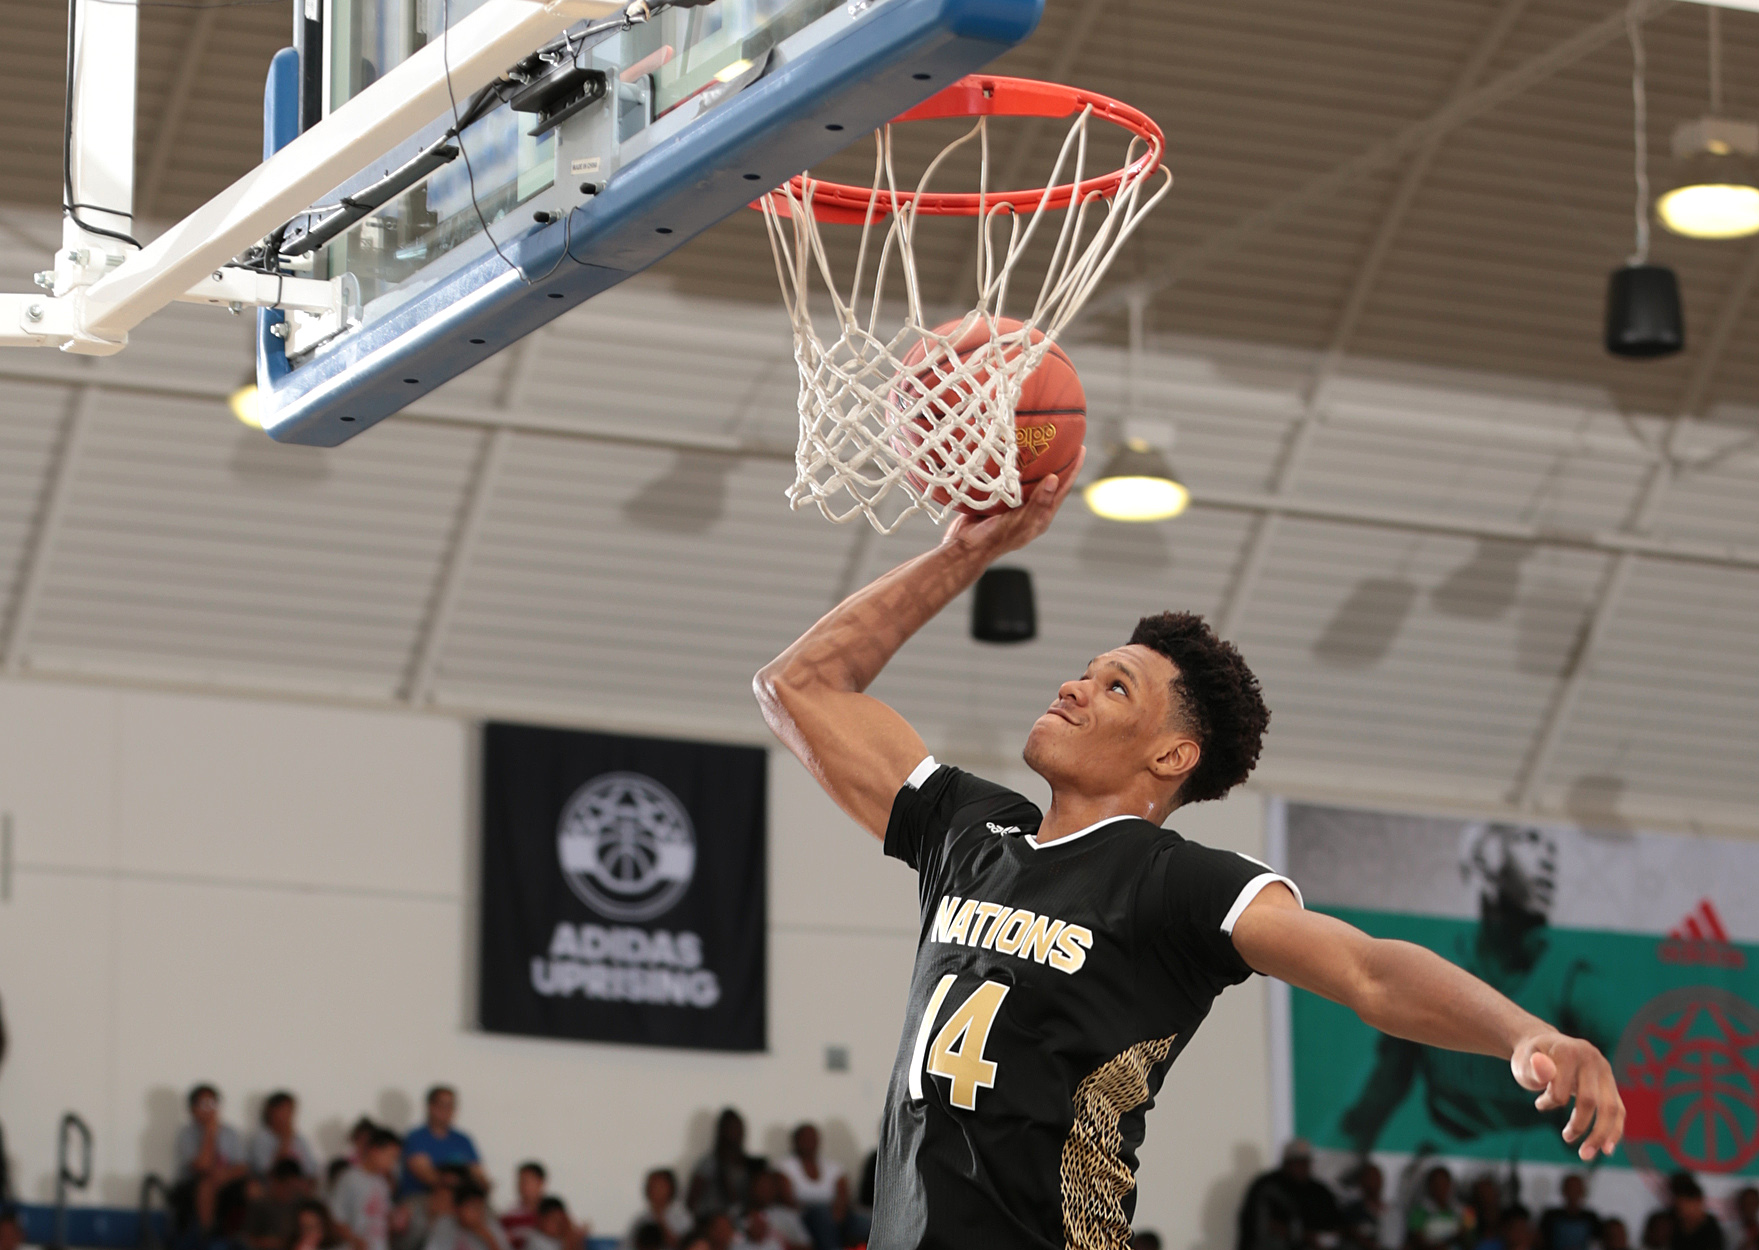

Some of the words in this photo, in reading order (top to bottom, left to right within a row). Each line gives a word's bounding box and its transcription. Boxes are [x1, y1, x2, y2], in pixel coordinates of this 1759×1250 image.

[550, 921, 703, 969] ADIDAS
[930, 895, 1094, 975] NATIONS
[528, 954, 721, 1009] UPRISING
[908, 974, 1010, 1111] 14
